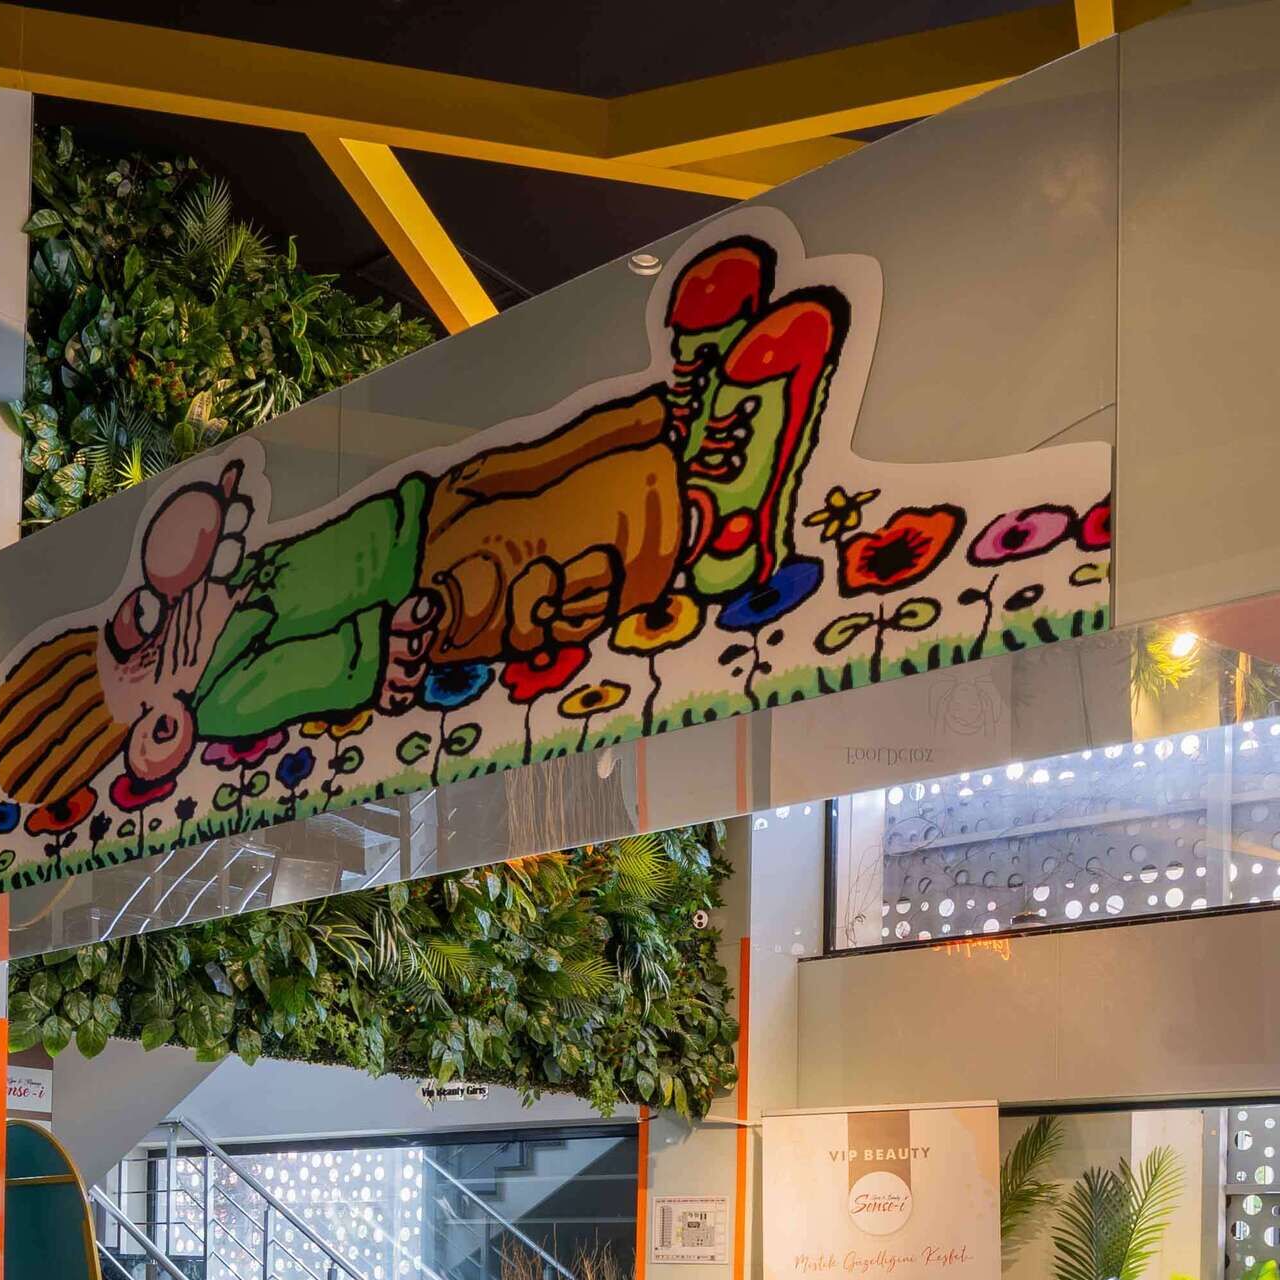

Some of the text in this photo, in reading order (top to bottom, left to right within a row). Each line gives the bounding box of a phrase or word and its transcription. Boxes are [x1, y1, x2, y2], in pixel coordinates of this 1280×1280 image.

[8, 1086, 45, 1098] nse-i
[828, 1147, 931, 1162] VIP BEAUTY
